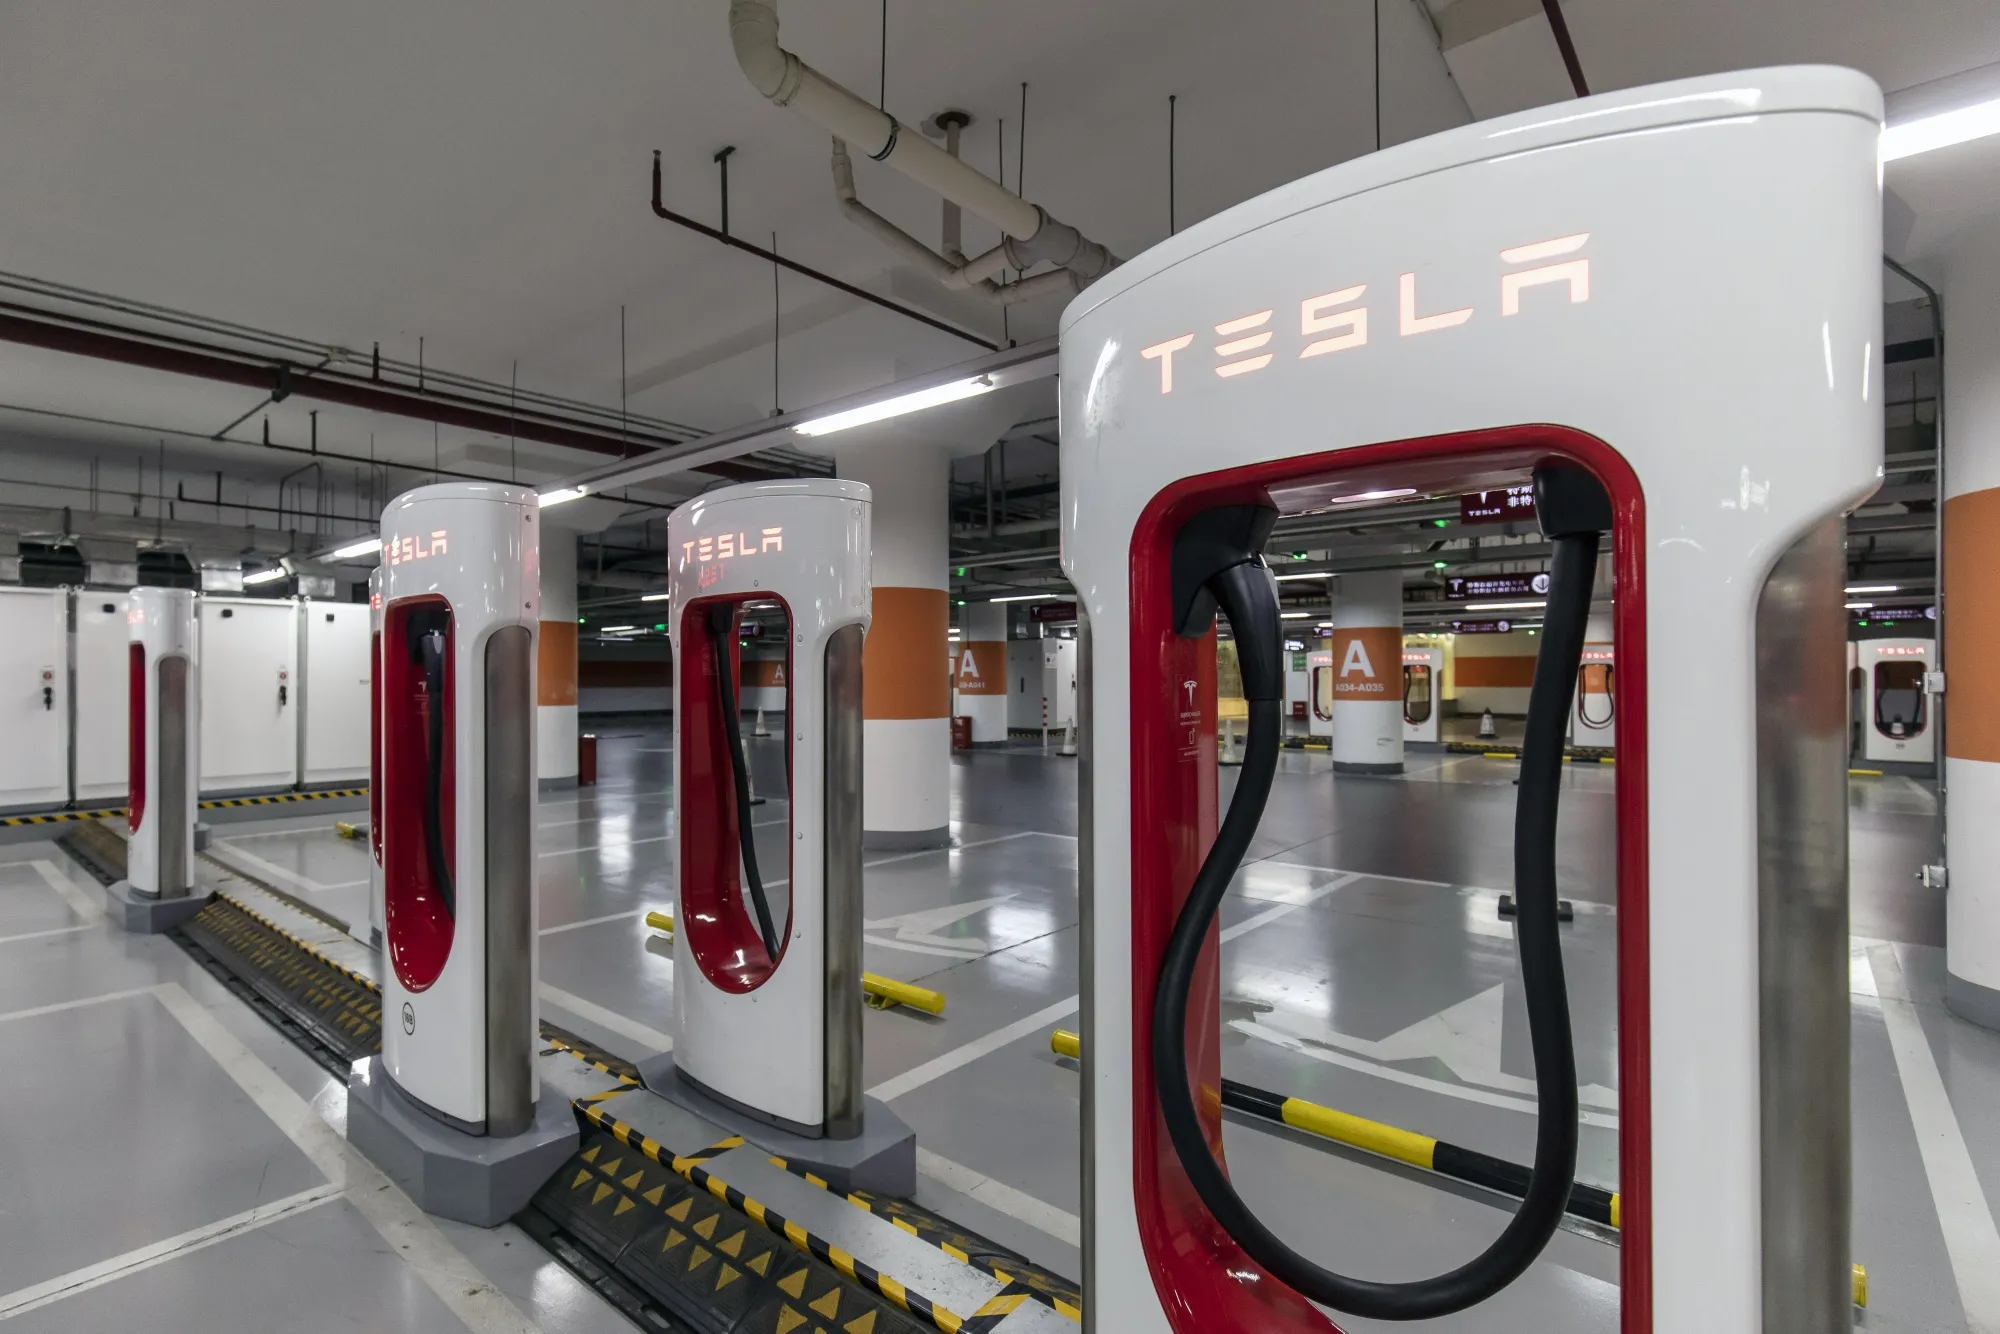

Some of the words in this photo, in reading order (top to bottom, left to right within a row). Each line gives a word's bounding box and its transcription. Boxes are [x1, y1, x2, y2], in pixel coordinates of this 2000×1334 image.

[1140, 232, 1590, 393] TESLA
[1468, 508, 1501, 516] TESLA
[384, 530, 447, 568] TESLA
[682, 527, 783, 564] TESLA
[960, 649, 980, 678] A
[1340, 640, 1375, 677] A
[1876, 646, 1925, 654] TESLA
[775, 664, 783, 679] A
